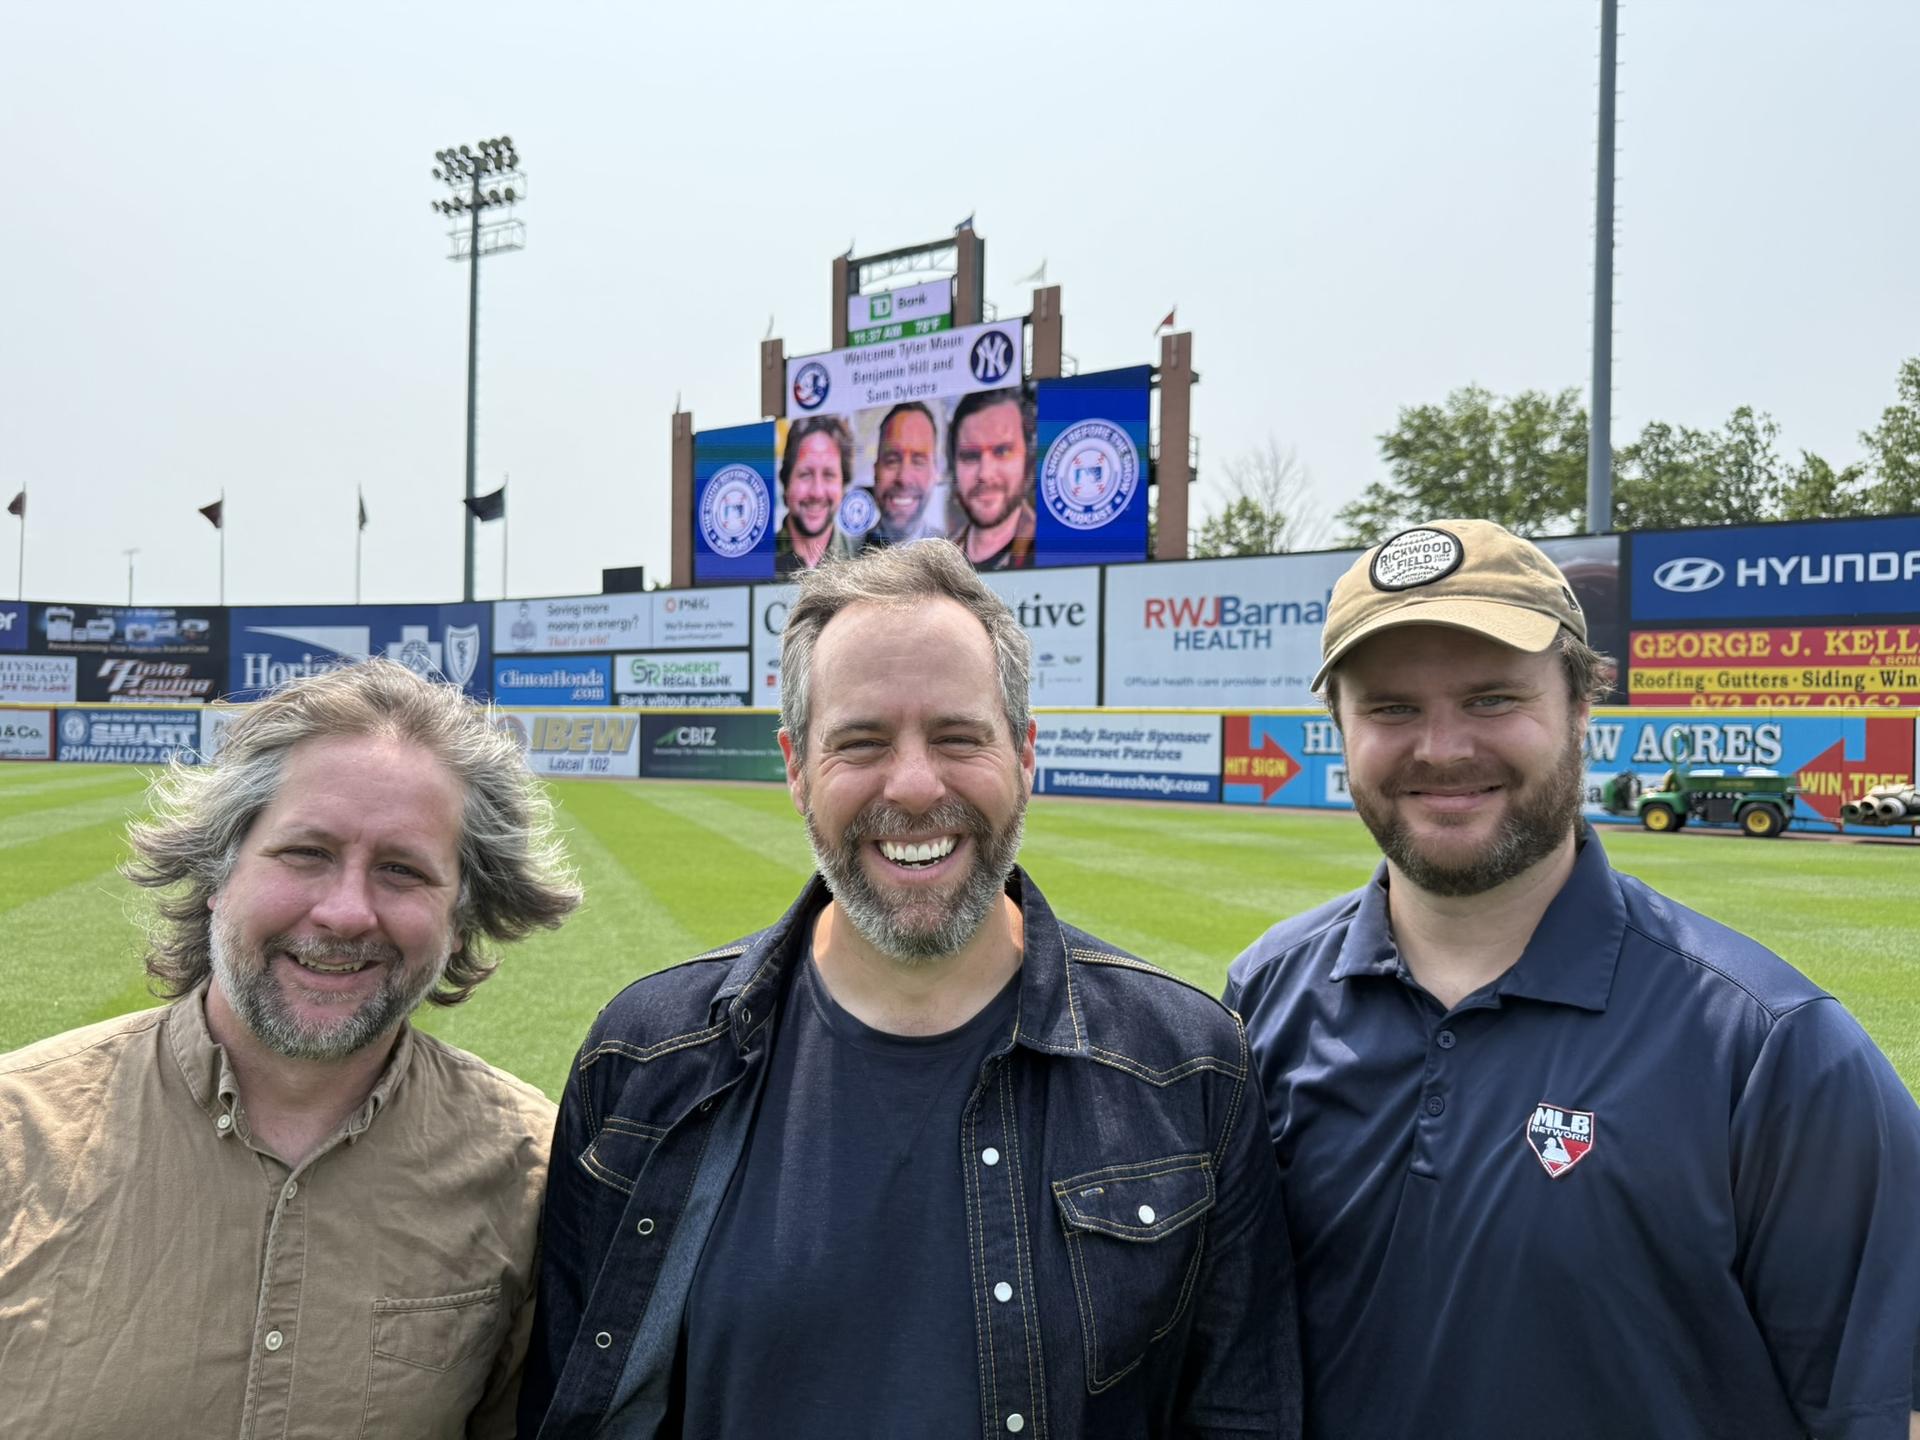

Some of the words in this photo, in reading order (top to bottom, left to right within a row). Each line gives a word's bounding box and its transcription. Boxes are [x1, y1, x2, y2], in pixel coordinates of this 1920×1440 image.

[844, 348, 896, 366] Welcome
[899, 342, 927, 359] Tyler
[853, 366, 905, 385] Benjamin
[908, 359, 929, 375] Hill
[932, 354, 954, 371] and
[867, 389, 890, 403] Sam
[1380, 541, 1452, 569] RICKWOOD
[1396, 554, 1433, 571] FIELD
[547, 604, 581, 616] Saving
[582, 603, 609, 614] more
[548, 621, 580, 633] money
[598, 614, 639, 632] energy?
[1173, 631, 1272, 651] HEALTH
[1633, 632, 1770, 658] GEORGE
[1780, 630, 1811, 657] J.
[1824, 628, 1920, 656] KELL
[662, 661, 721, 674] SOMERSET
[1886, 655, 1920, 667] SON
[499, 668, 604, 688] ClintonHonda
[662, 675, 698, 687] REGAL
[701, 675, 732, 687] BANK
[1123, 677, 1160, 687] Official
[1163, 677, 1195, 687] health
[1198, 678, 1220, 687] care
[1221, 677, 1267, 690] provider
[1270, 676, 1284, 687] of
[1285, 677, 1303, 686] the
[1633, 668, 1705, 691] Roofing
[1717, 669, 1789, 688] Gutters
[1802, 669, 1866, 691] Siding
[1880, 669, 1920, 688] Win
[571, 687, 605, 701] .com
[531, 717, 638, 756] IBEW
[677, 726, 716, 746] CBIZ
[1060, 727, 1094, 744] Body
[1097, 727, 1144, 745] Repair
[1147, 730, 1211, 749] Sponsor
[1632, 723, 1783, 764] ACRES
[1054, 745, 1120, 759] Somerset
[550, 756, 584, 770] Local
[589, 757, 610, 772] 102
[1225, 756, 1249, 776] HIT
[1251, 757, 1288, 778] SIGN
[1800, 771, 1842, 796] WIN
[1532, 1107, 1590, 1135] MLB
[1531, 1125, 1590, 1143] NETWORK
